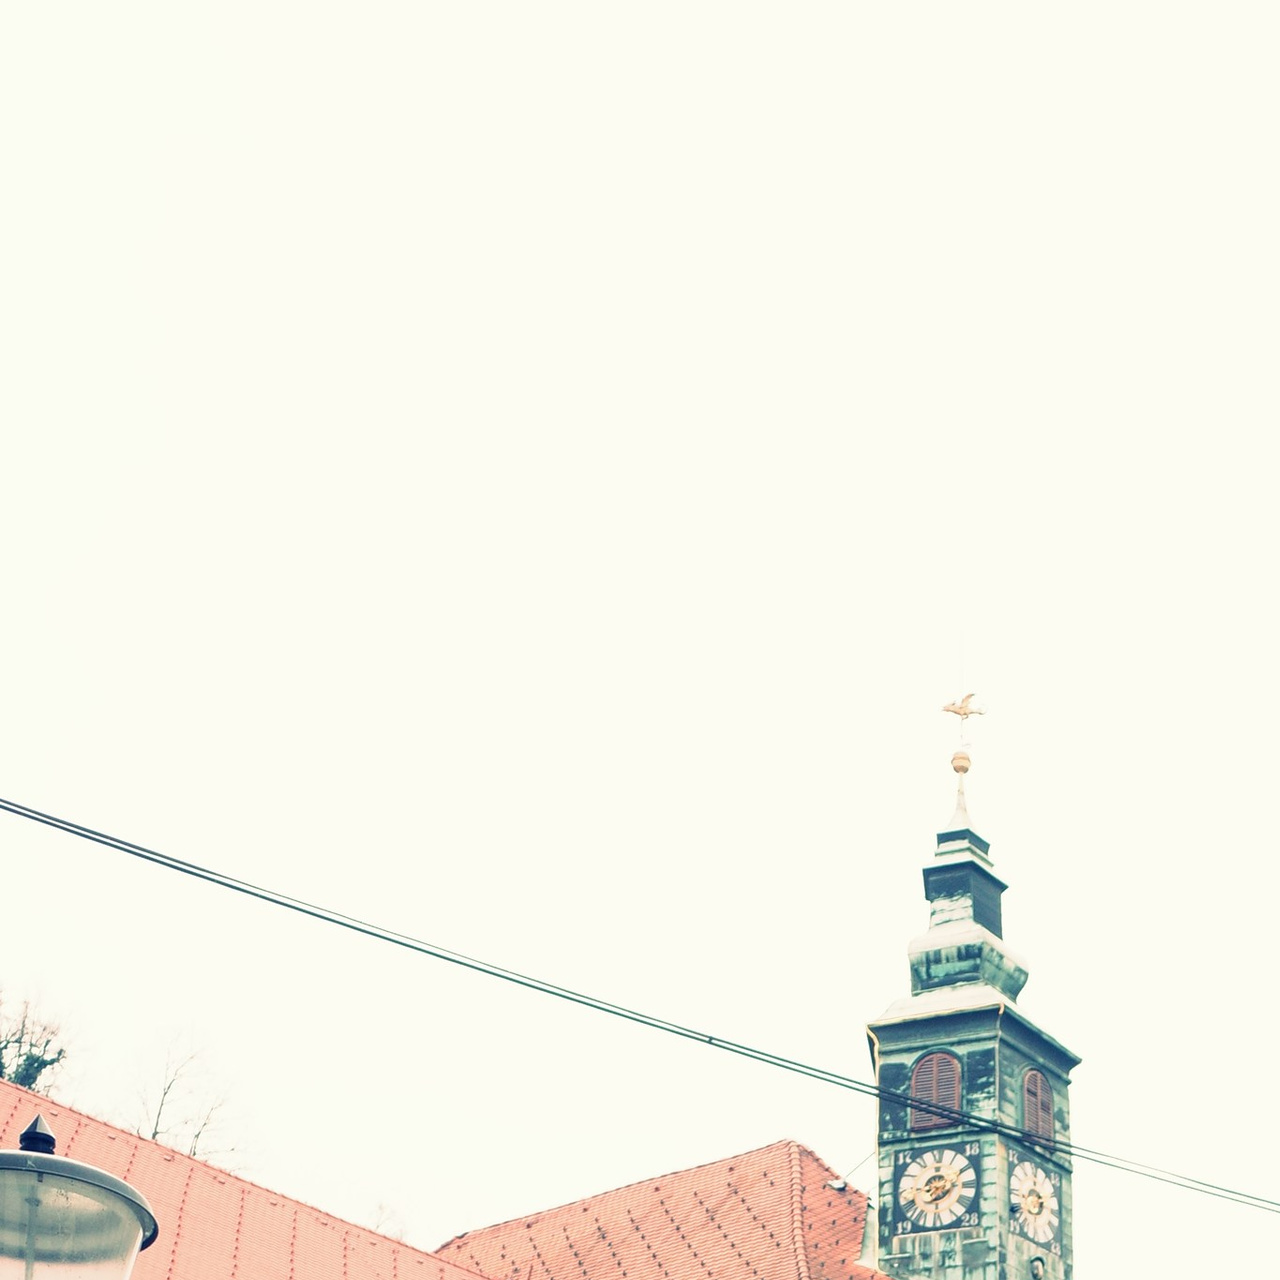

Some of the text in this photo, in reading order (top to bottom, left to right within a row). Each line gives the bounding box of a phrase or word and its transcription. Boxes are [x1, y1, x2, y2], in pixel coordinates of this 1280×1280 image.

[964, 1142, 980, 1156] 18
[896, 1212, 979, 1234] 19 28
